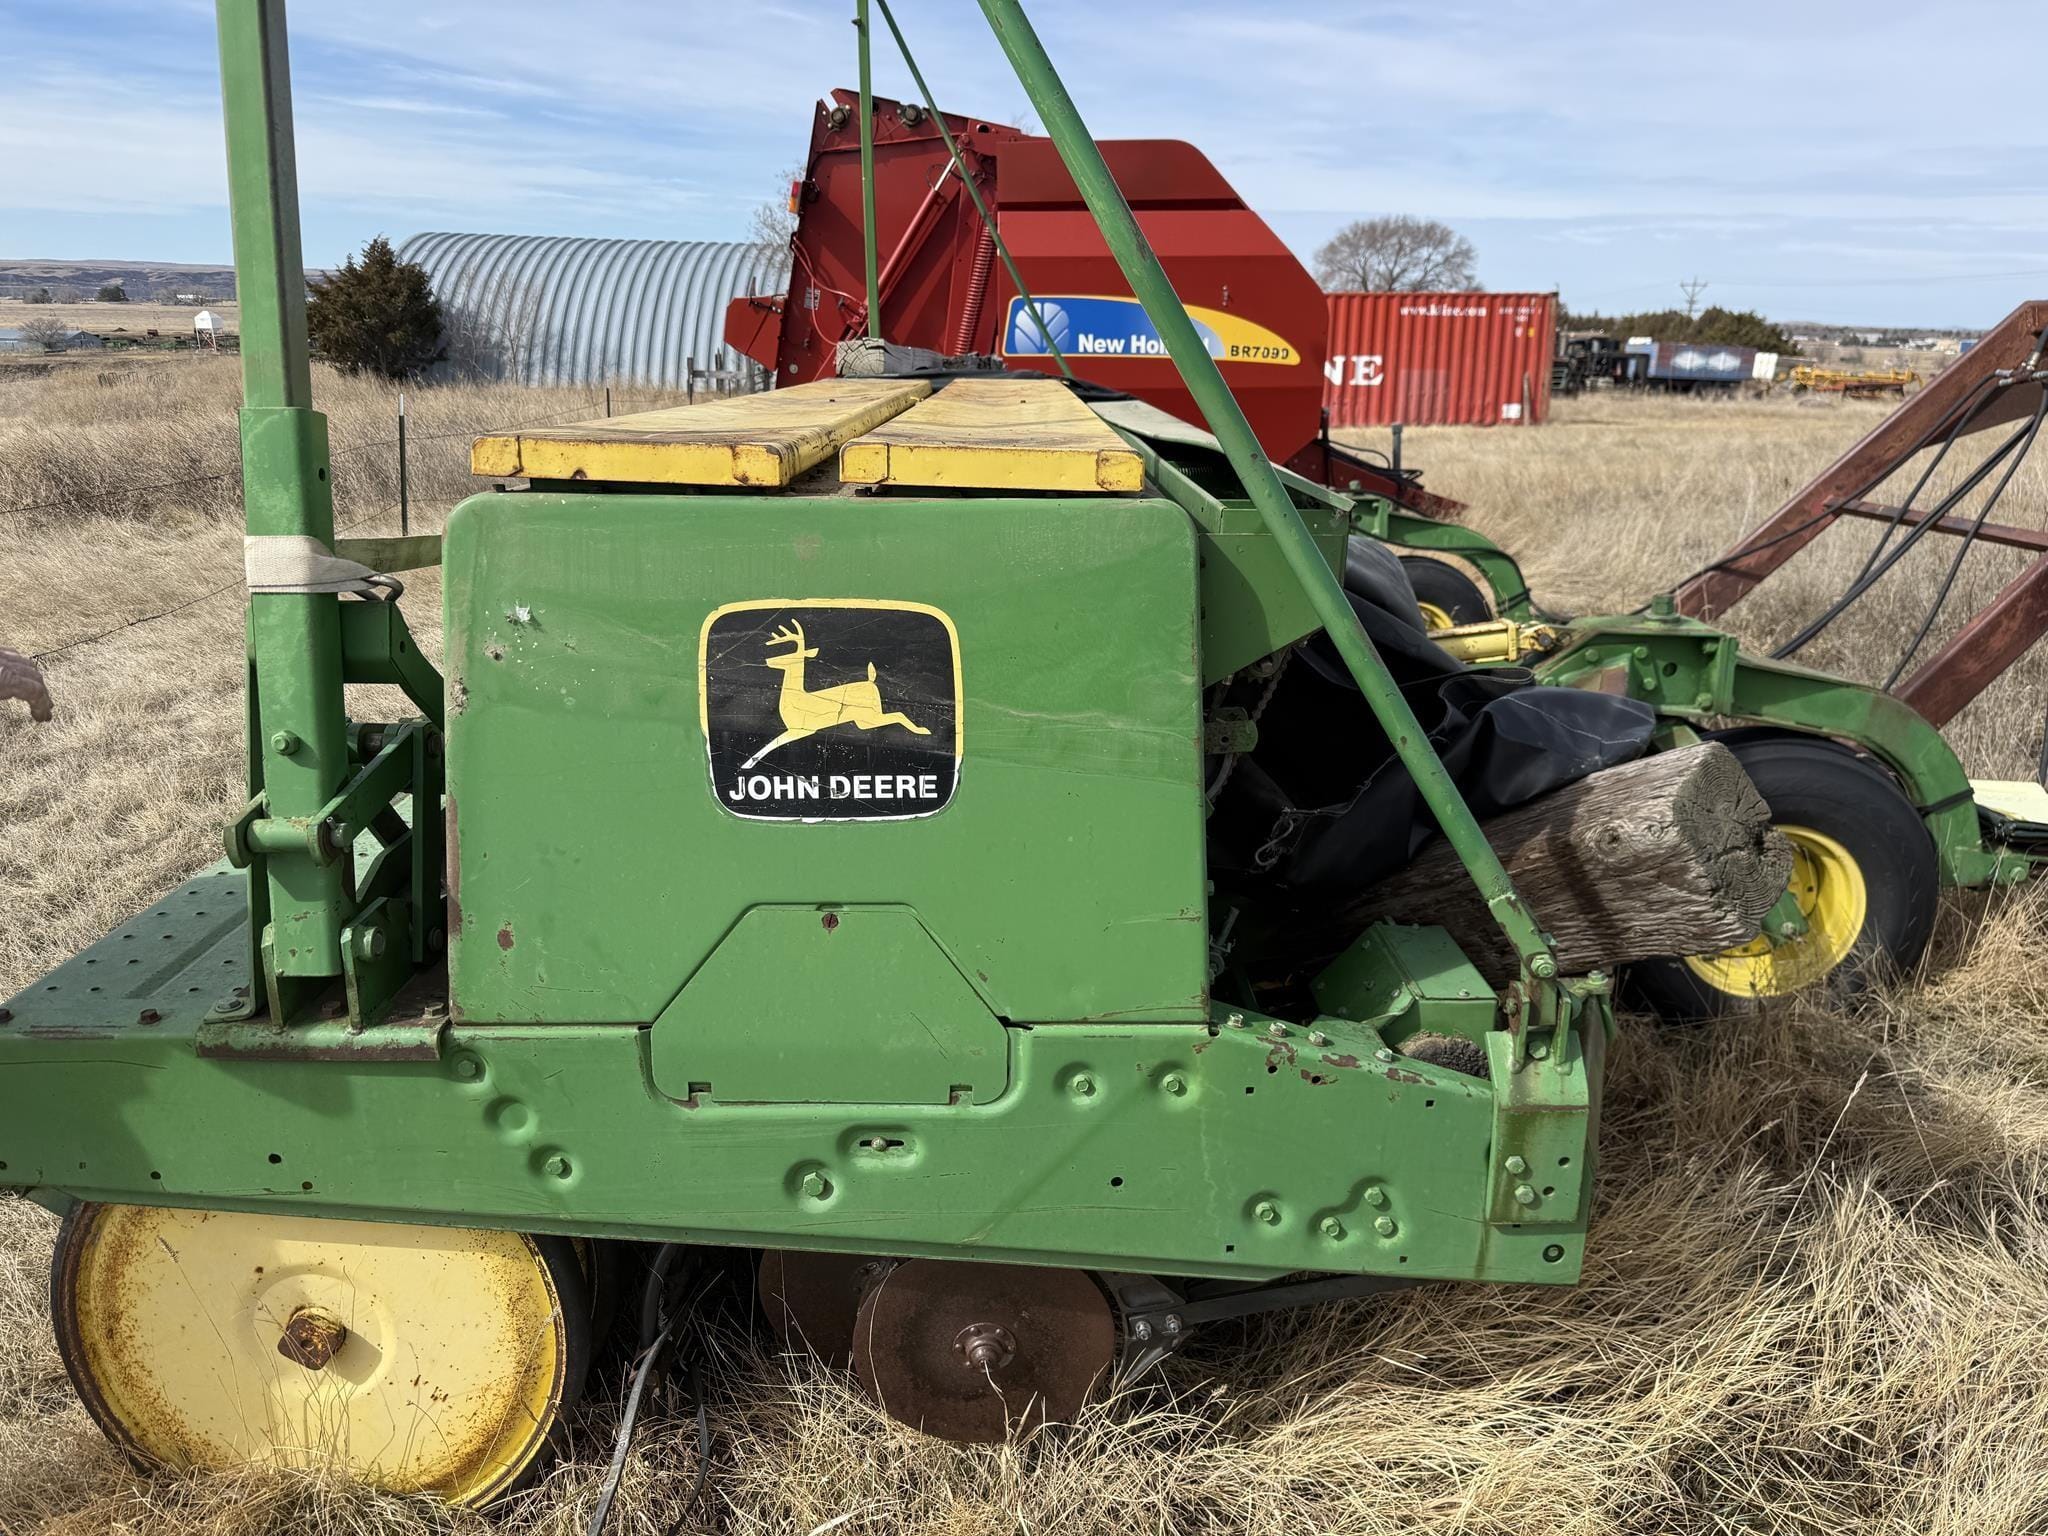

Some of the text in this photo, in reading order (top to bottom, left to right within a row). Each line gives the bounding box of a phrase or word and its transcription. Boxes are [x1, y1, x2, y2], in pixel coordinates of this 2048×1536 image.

[1078, 333, 1125, 353] New
[1230, 345, 1290, 360] BR7090
[729, 775, 938, 800] JOHN DEERE
